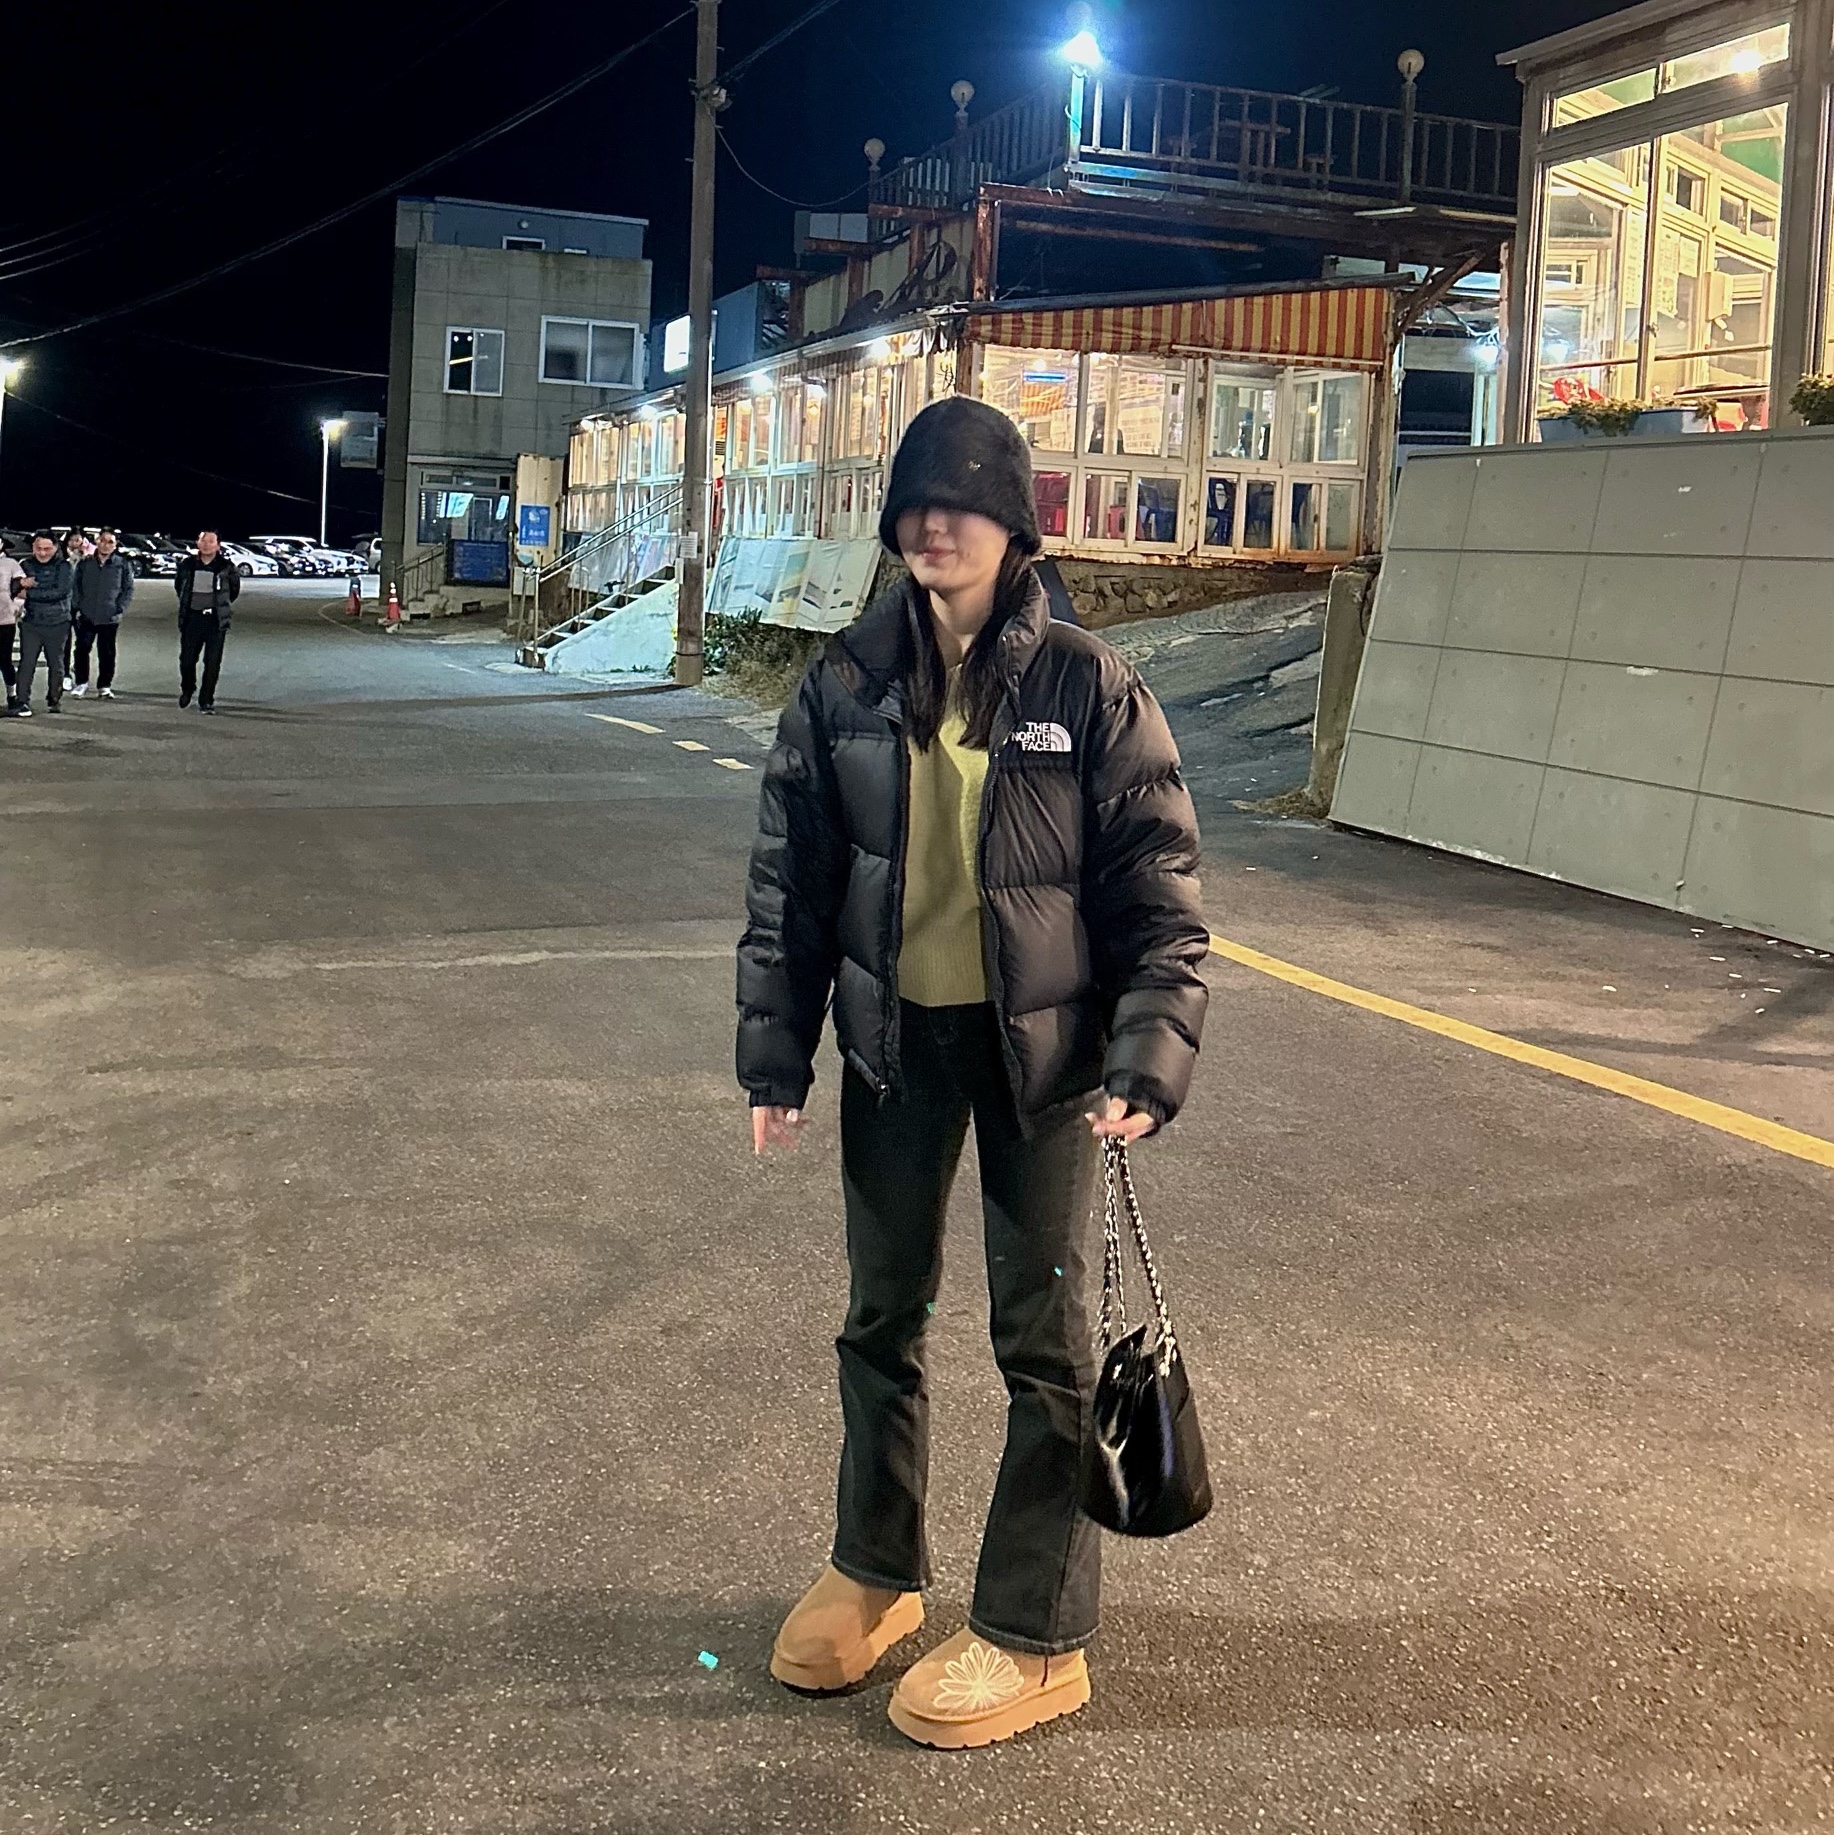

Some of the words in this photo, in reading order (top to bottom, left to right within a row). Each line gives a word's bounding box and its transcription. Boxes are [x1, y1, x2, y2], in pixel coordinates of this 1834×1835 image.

[1025, 722, 1050, 732] THE
[1011, 731, 1050, 741] NORTH
[1021, 741, 1051, 751] FACE
